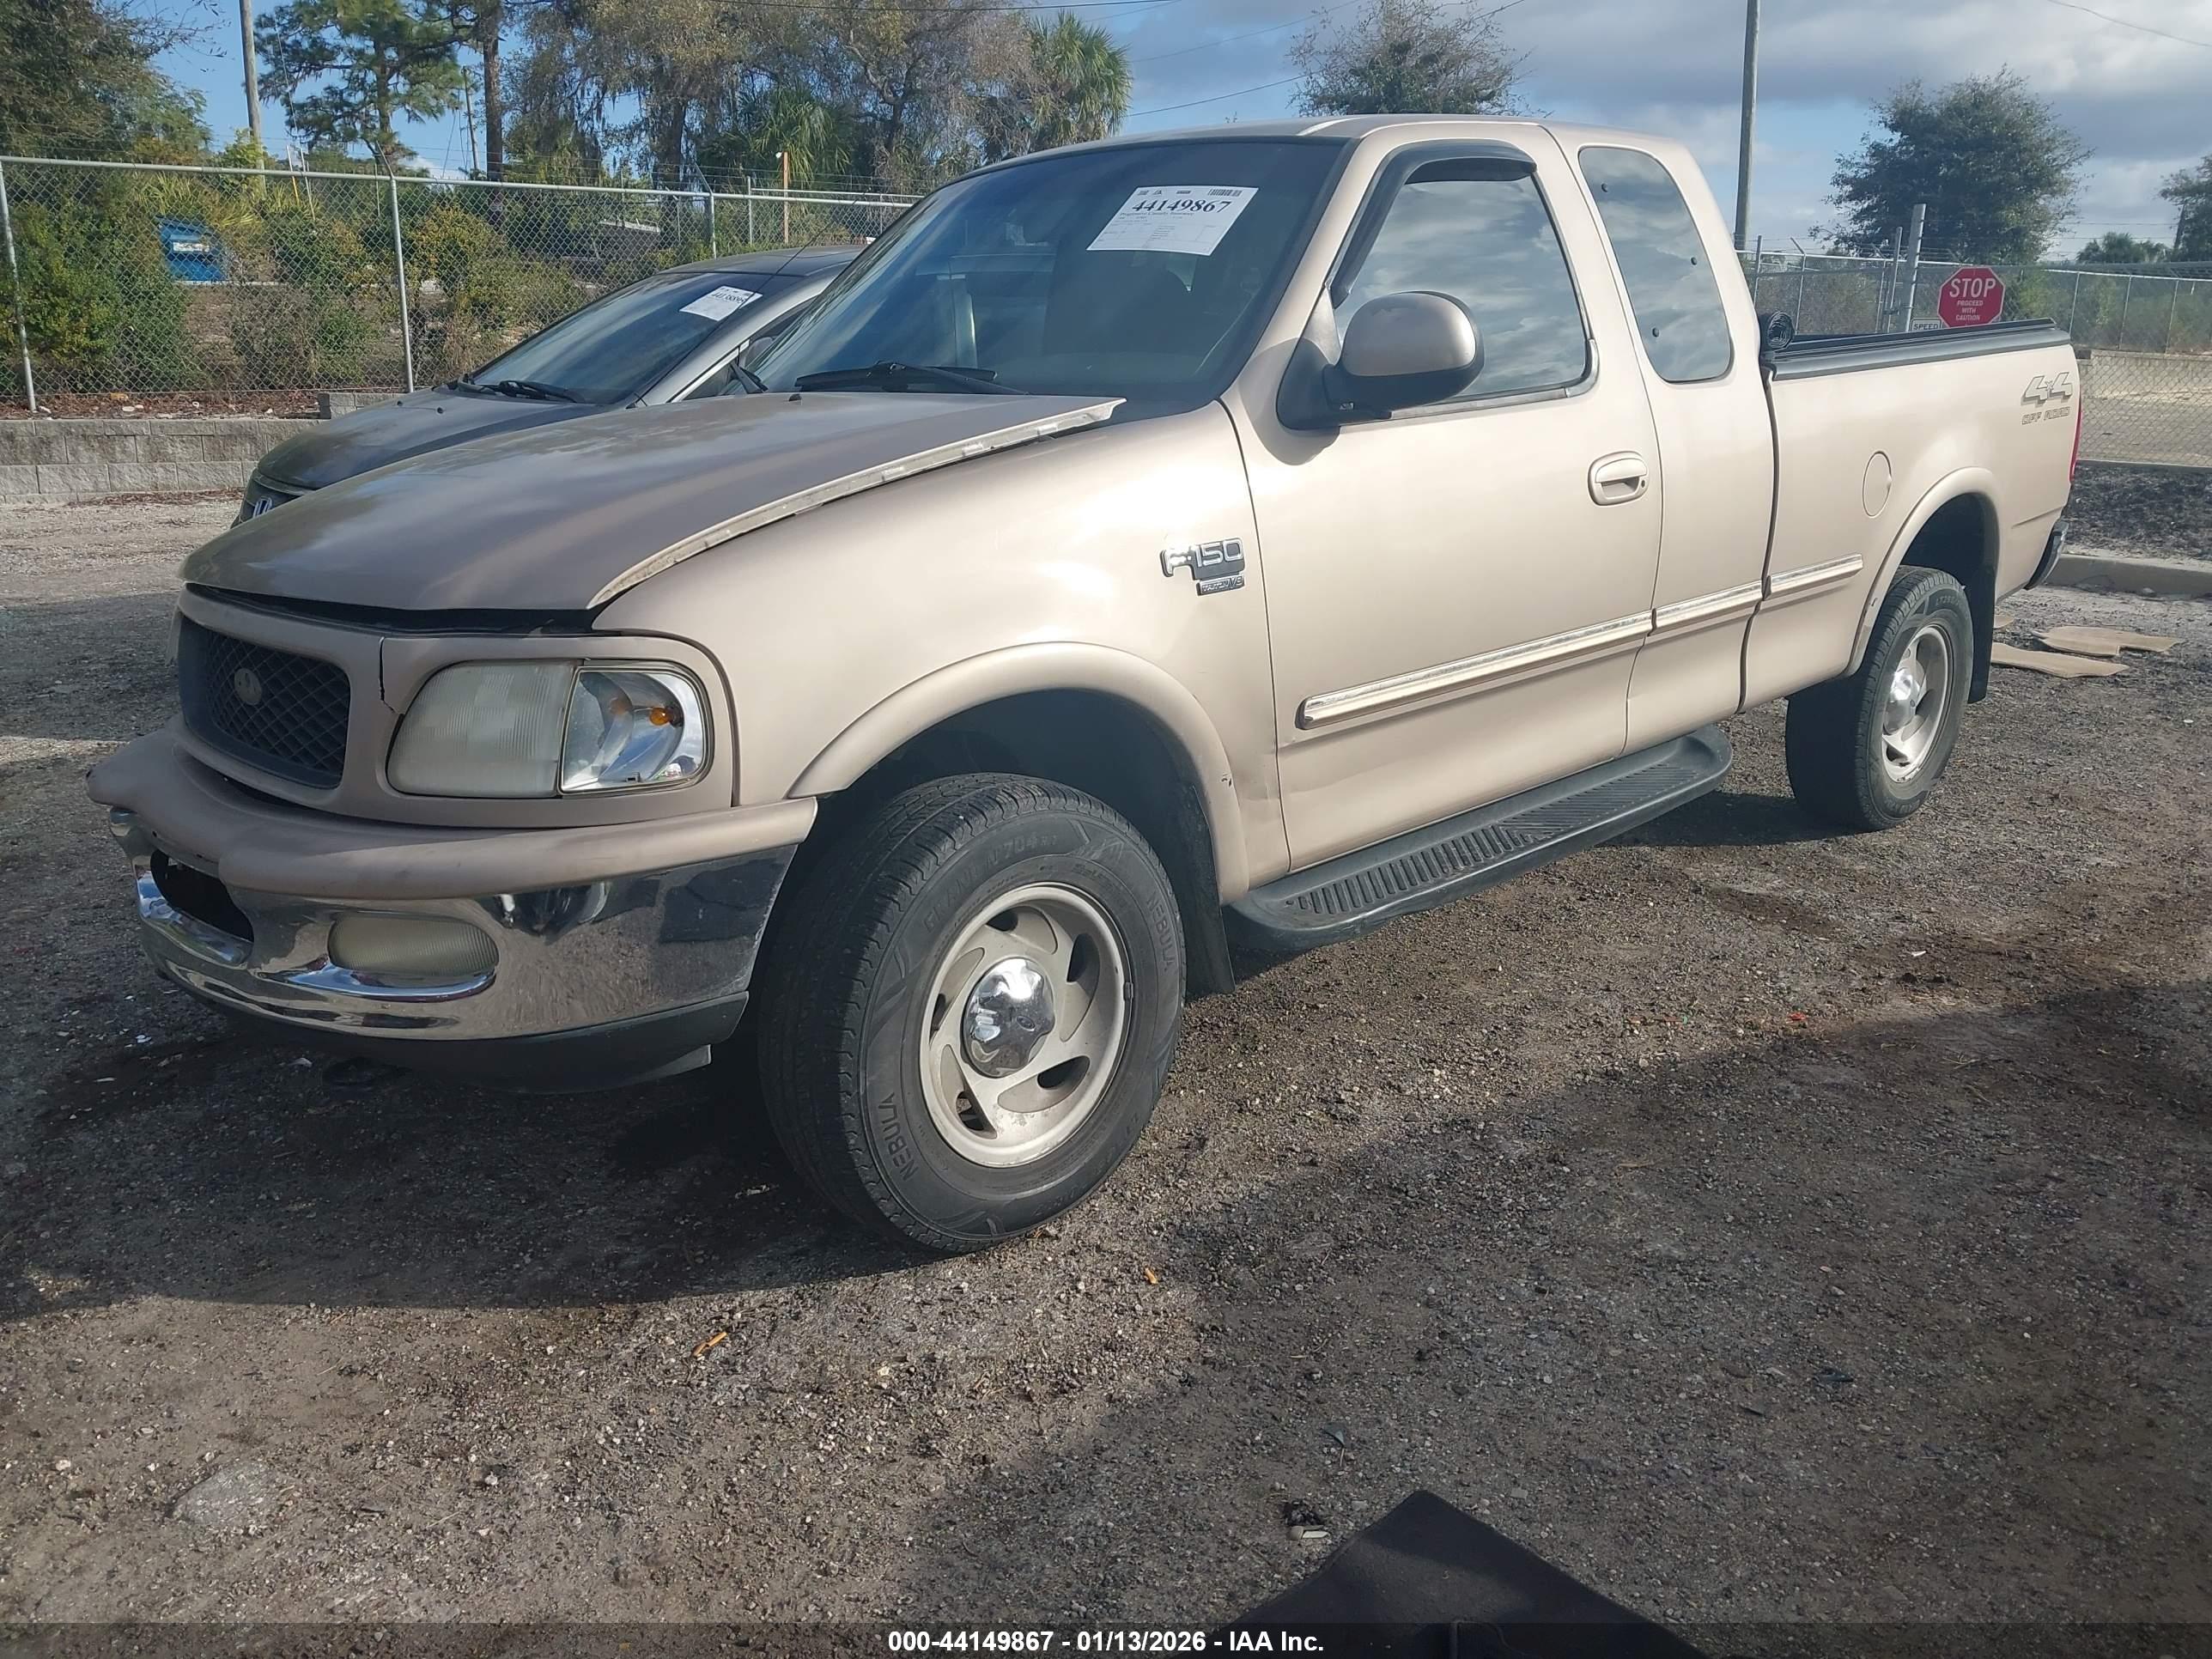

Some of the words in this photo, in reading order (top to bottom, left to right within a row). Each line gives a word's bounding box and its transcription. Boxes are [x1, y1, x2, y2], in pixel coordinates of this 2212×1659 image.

[1132, 198, 1232, 213] 44149867
[1949, 277, 1996, 298] STOP
[2021, 412, 2042, 425] OFF
[2044, 406, 2071, 421] ROAD
[1146, 890, 1176, 973] NEBULA
[878, 1091, 921, 1182] NEBULA
